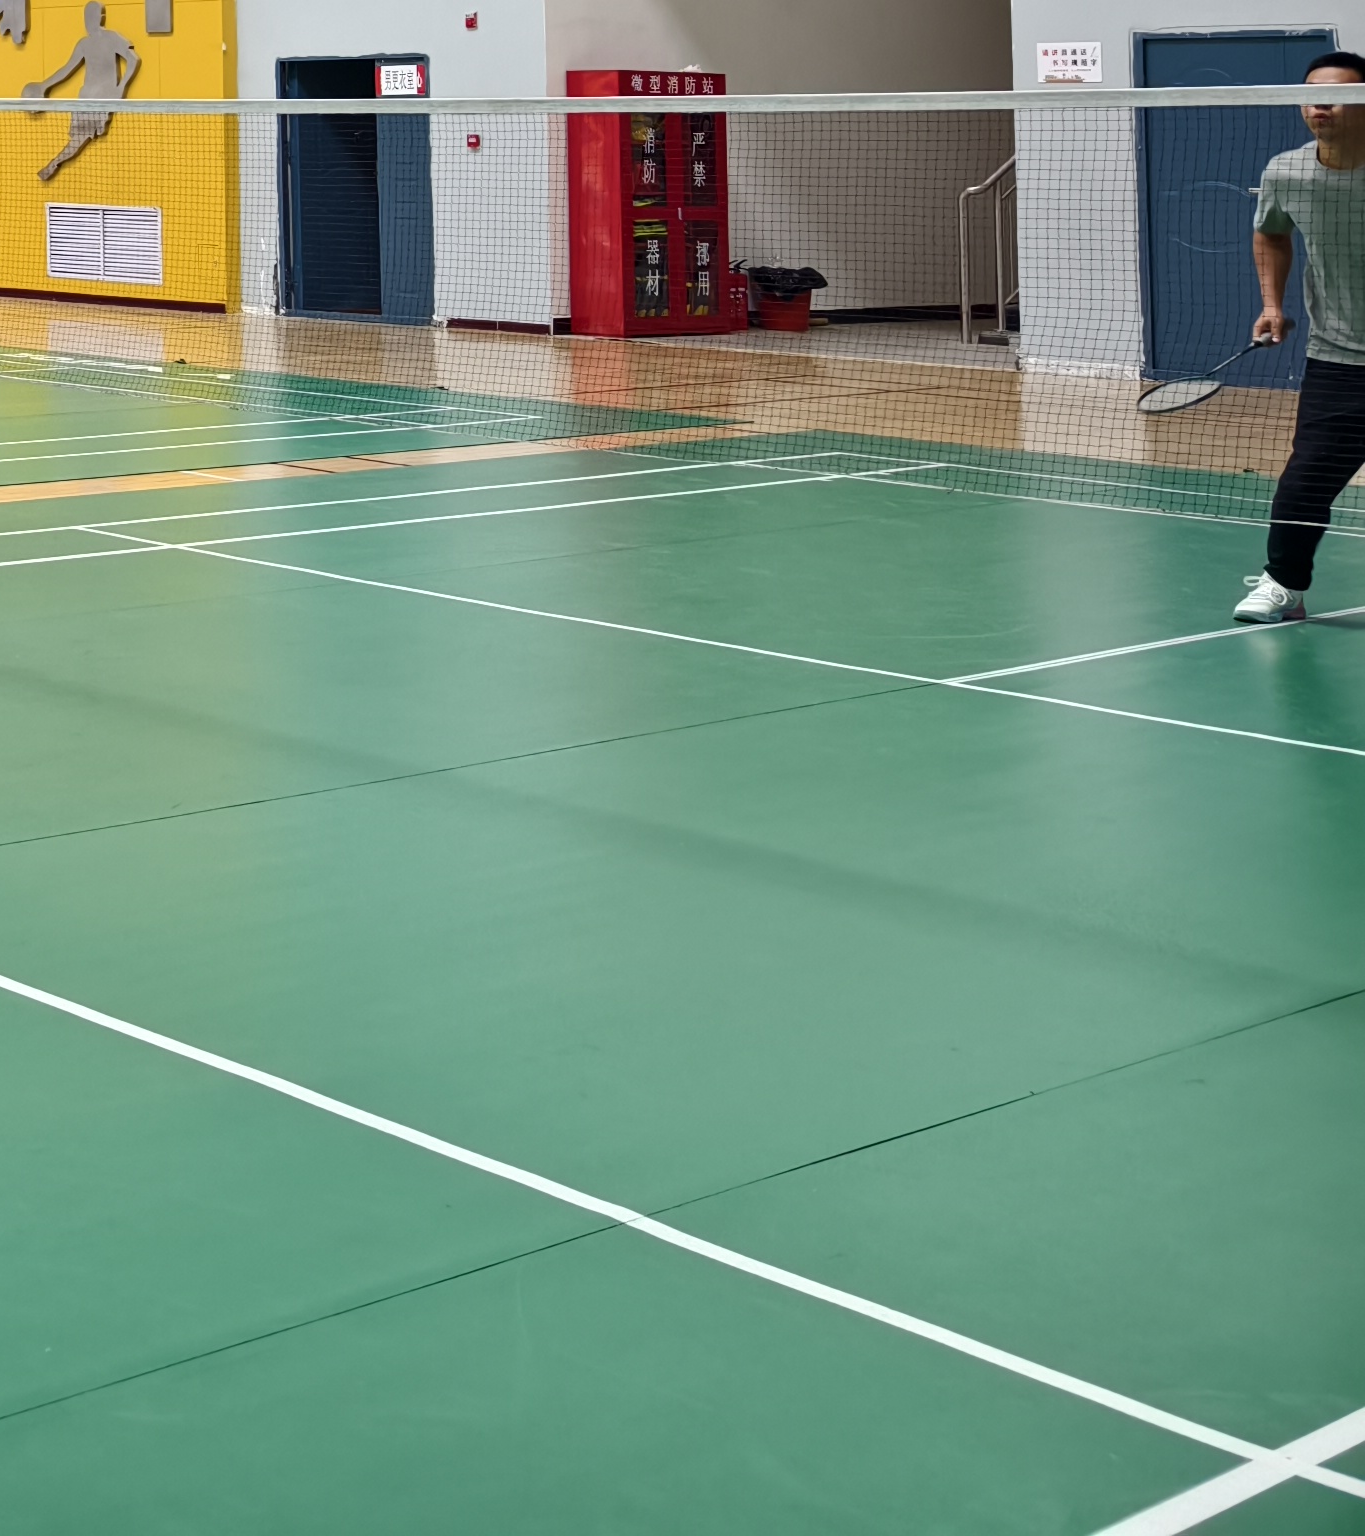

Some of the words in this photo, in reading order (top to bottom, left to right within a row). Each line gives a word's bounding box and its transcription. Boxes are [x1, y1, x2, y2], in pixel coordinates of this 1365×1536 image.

[384, 70, 415, 91] 男更衣室
[631, 74, 714, 95] 微型消防站
[642, 127, 657, 185] 消防
[691, 132, 706, 188] 严禁
[645, 239, 660, 297] 器材
[695, 240, 710, 297] 挪用
